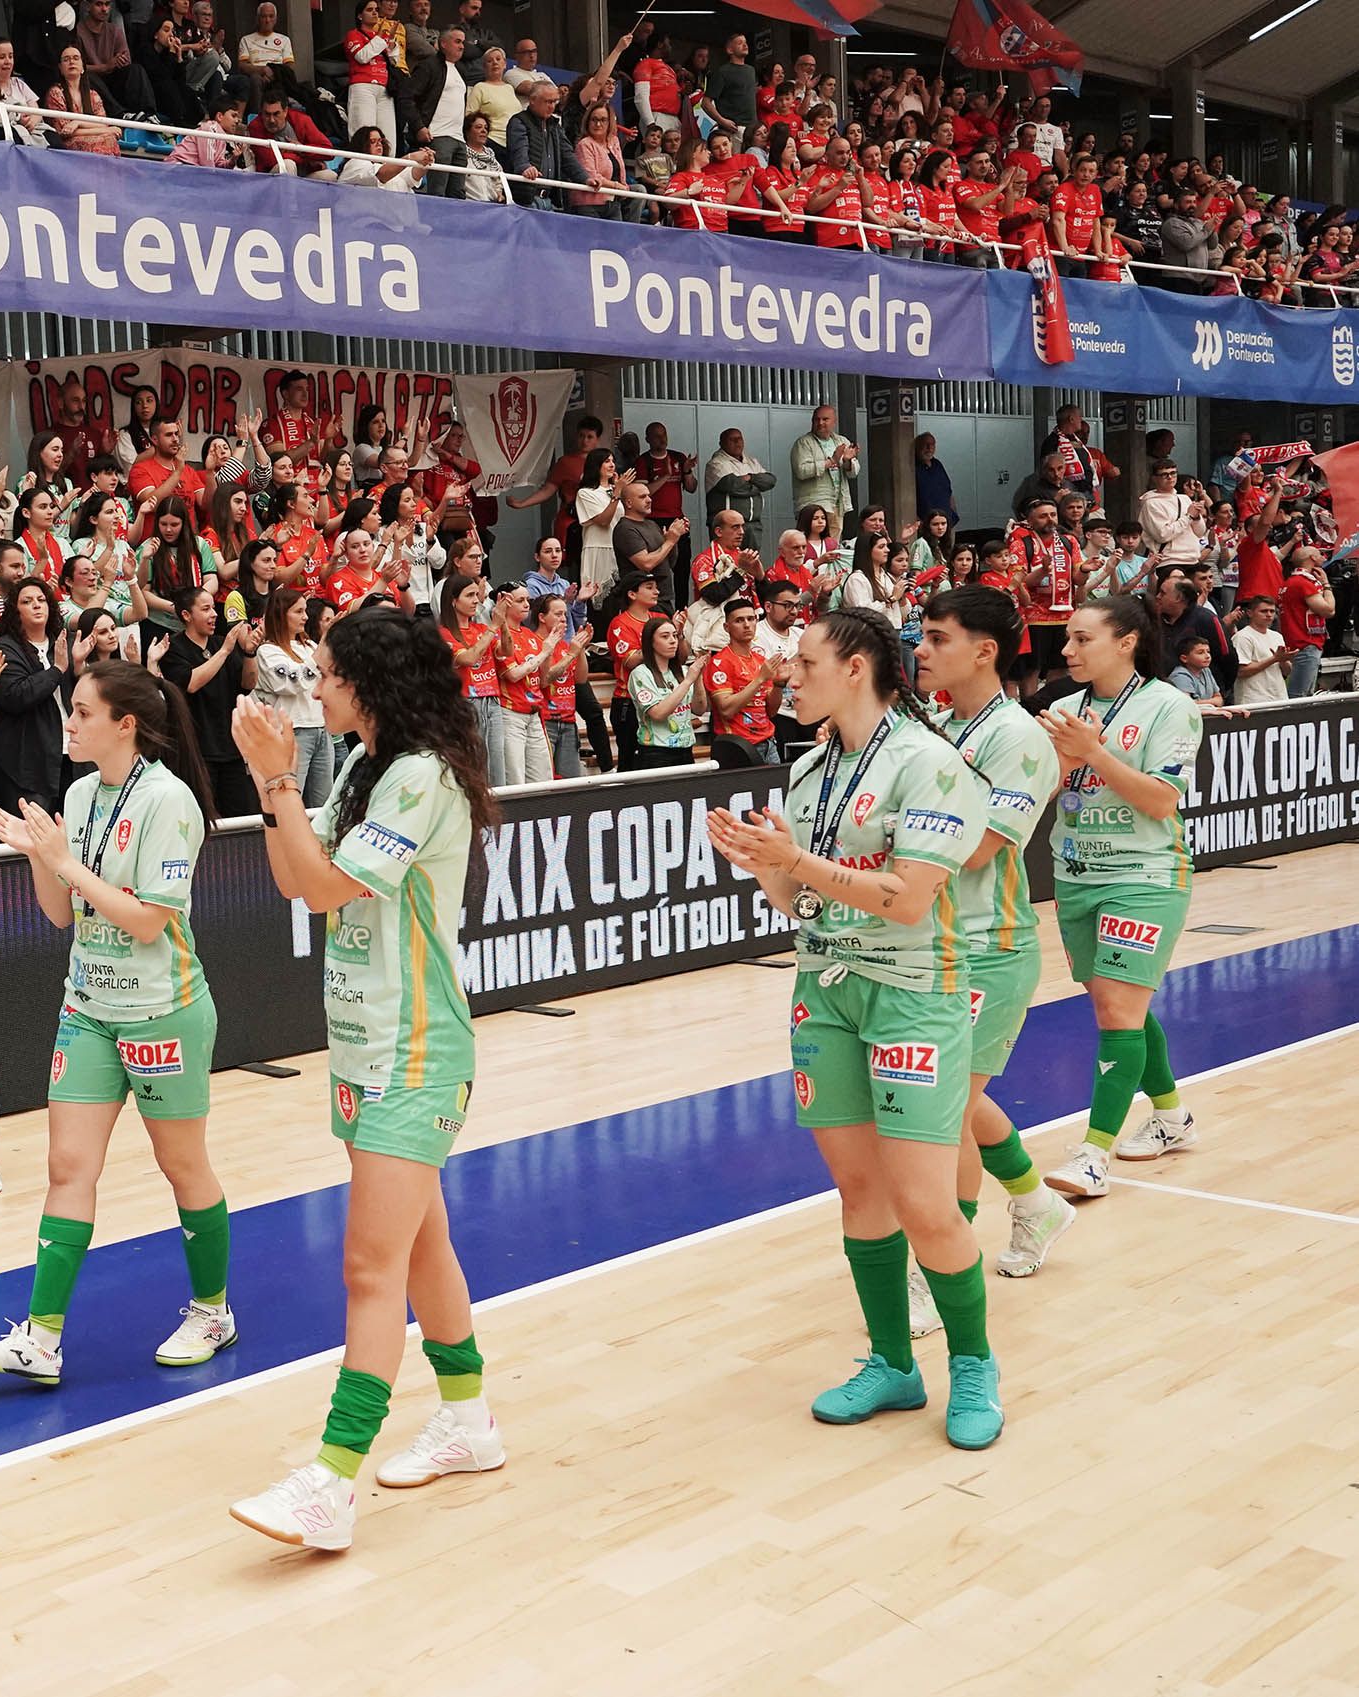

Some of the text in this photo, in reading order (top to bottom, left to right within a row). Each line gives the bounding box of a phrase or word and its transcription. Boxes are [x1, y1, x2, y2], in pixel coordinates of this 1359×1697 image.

[590, 249, 931, 357] Pontevedra
[1067, 320, 1100, 336] oncello
[1076, 339, 1126, 354] Pontevedra
[161, 360, 242, 437] DAR
[902, 396, 912, 413] C
[1137, 407, 1144, 422] C
[1209, 729, 1258, 805] XIX
[1265, 720, 1332, 795] COPA
[1079, 806, 1134, 824] ence
[1185, 809, 1256, 857] EMININA
[1261, 803, 1282, 843] DE
[1286, 791, 1347, 838] FÚTBOL
[357, 823, 416, 865] FAYFER
[1076, 841, 1112, 851] XUNTA
[482, 816, 575, 925] XIX
[588, 797, 718, 905] COPA
[162, 866, 189, 880] FAY
[1100, 915, 1160, 944] FROIZ
[456, 924, 577, 994] MININA
[584, 914, 624, 972] DE
[631, 894, 744, 962] FÚTBOL
[83, 962, 115, 976] XUNTA
[95, 978, 139, 990] GALICIA
[330, 986, 364, 1004] ALICIA
[118, 1041, 179, 1065] FROIZ
